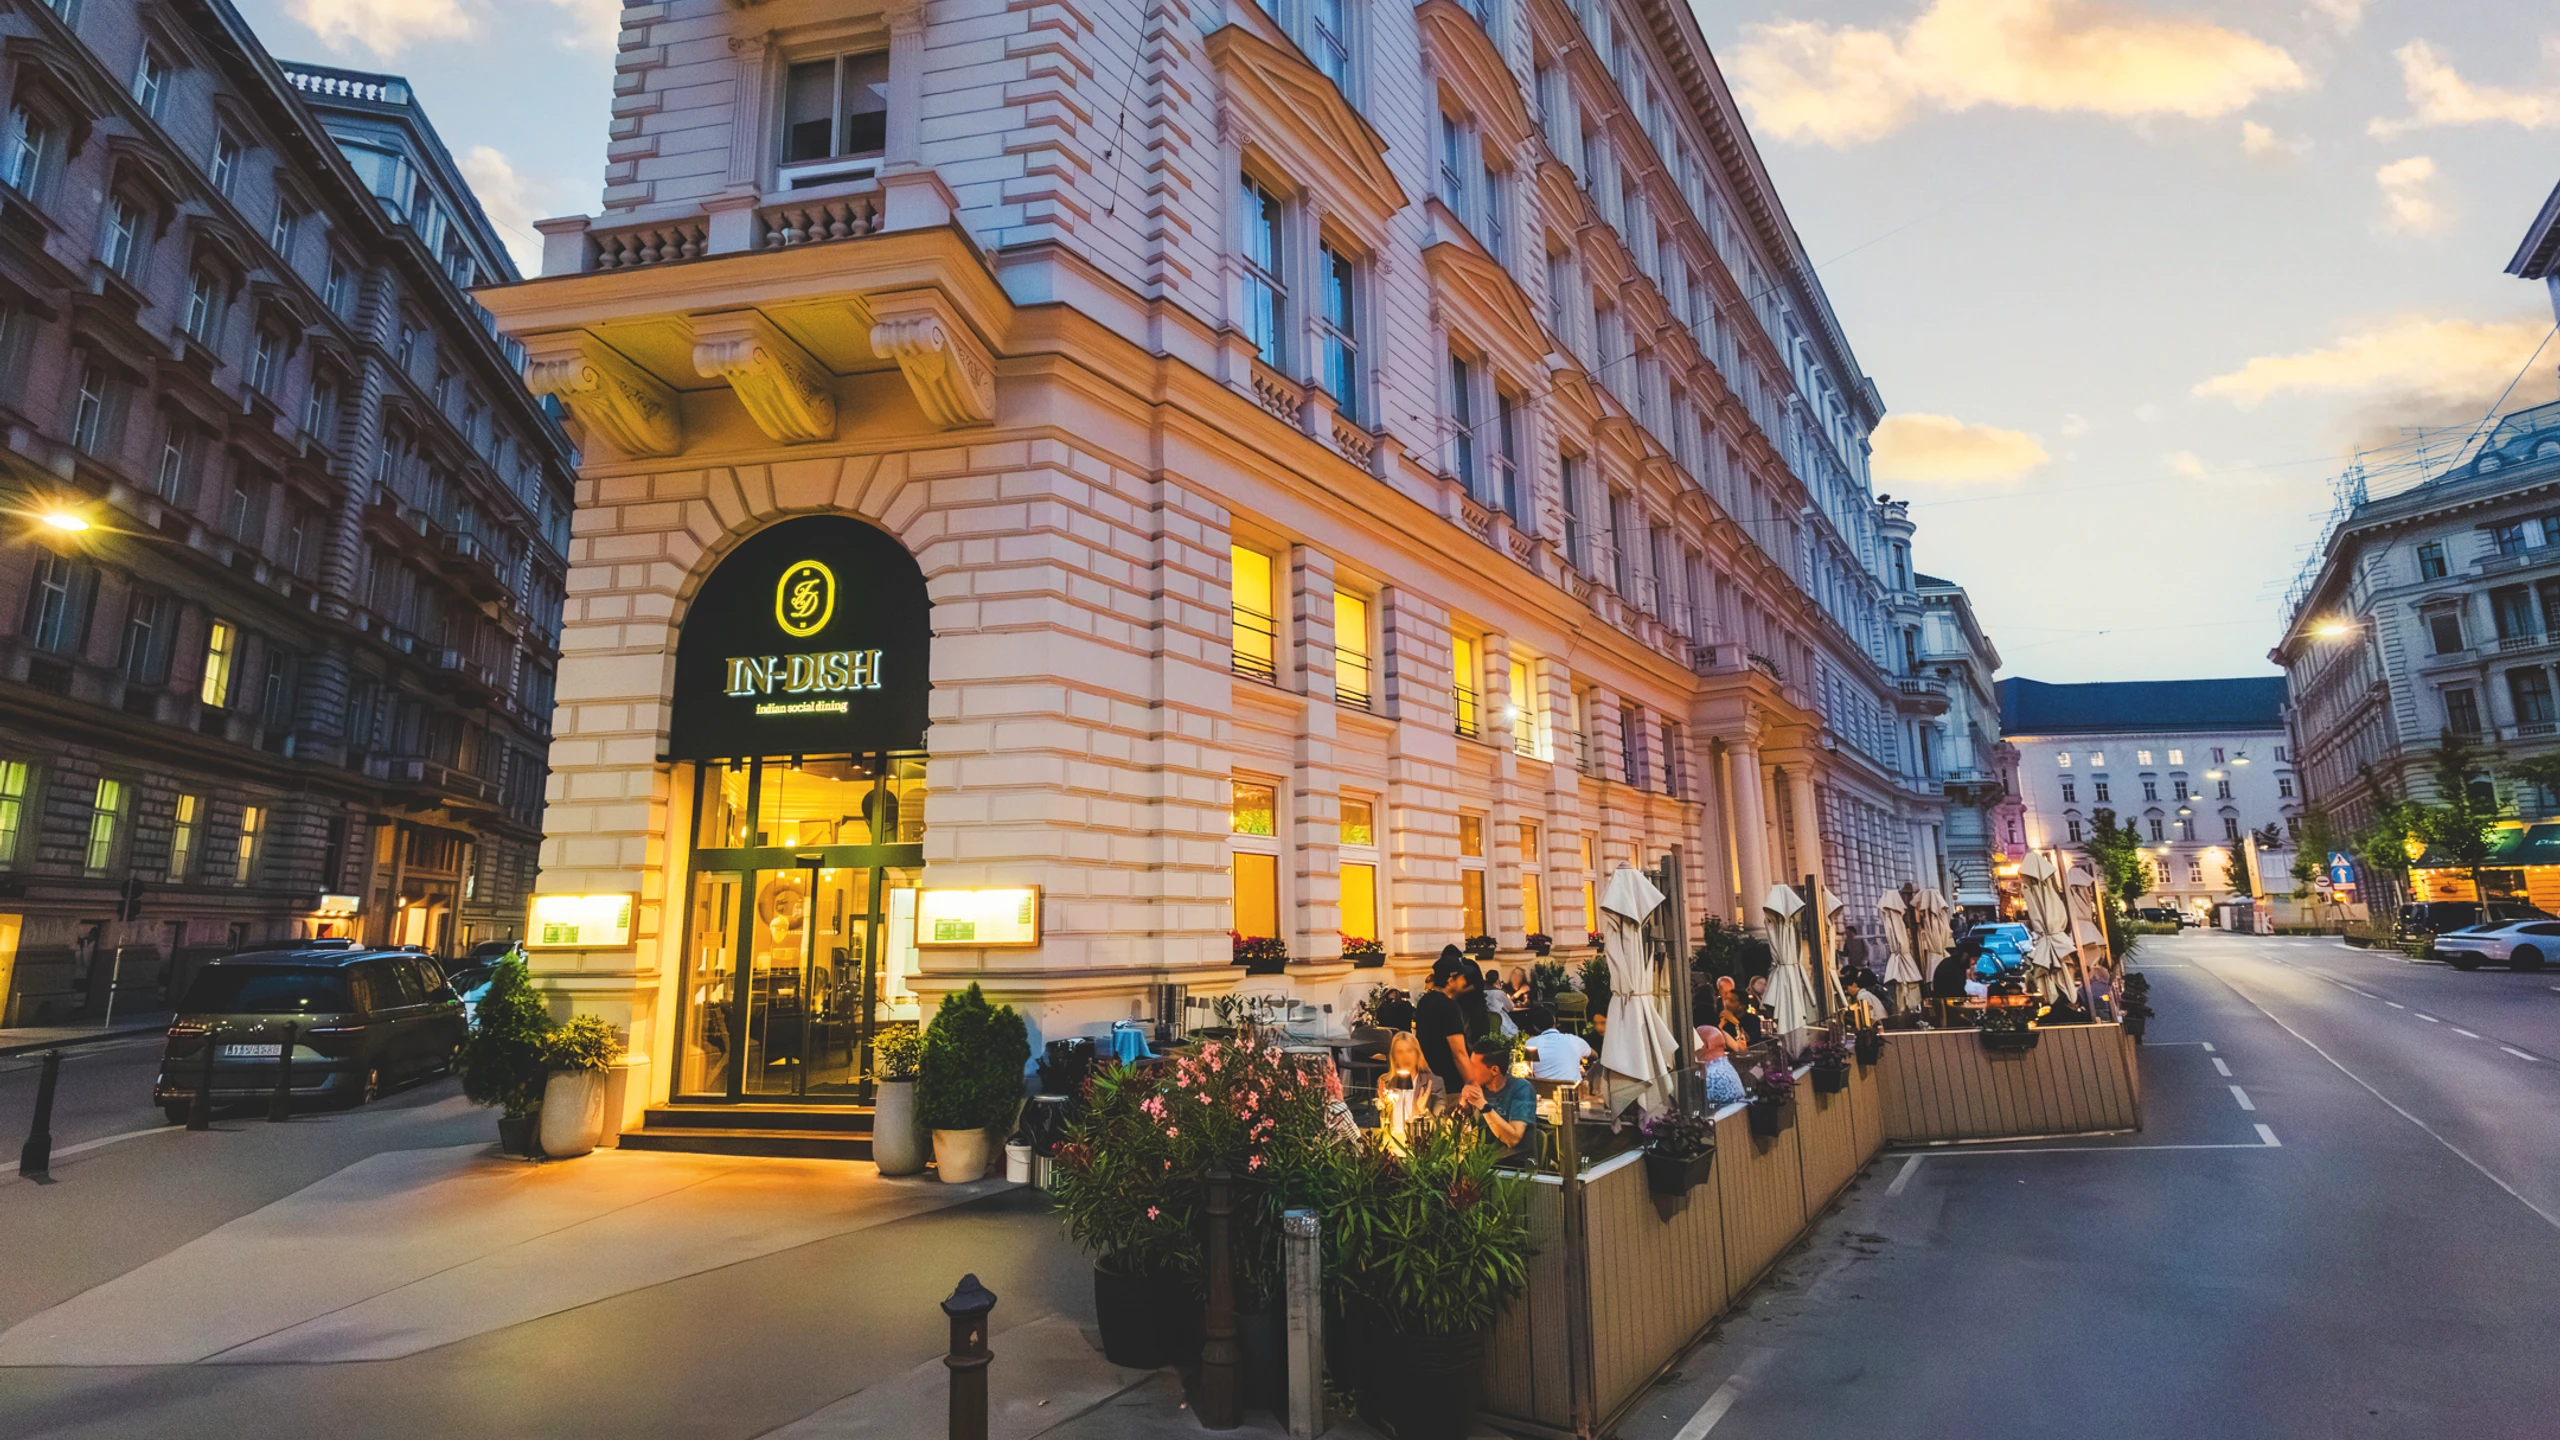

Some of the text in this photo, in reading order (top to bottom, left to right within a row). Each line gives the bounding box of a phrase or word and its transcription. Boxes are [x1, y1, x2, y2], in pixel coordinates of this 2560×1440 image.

[723, 649, 883, 696] IN-DISH
[787, 701, 815, 713] social
[815, 700, 849, 713] dining
